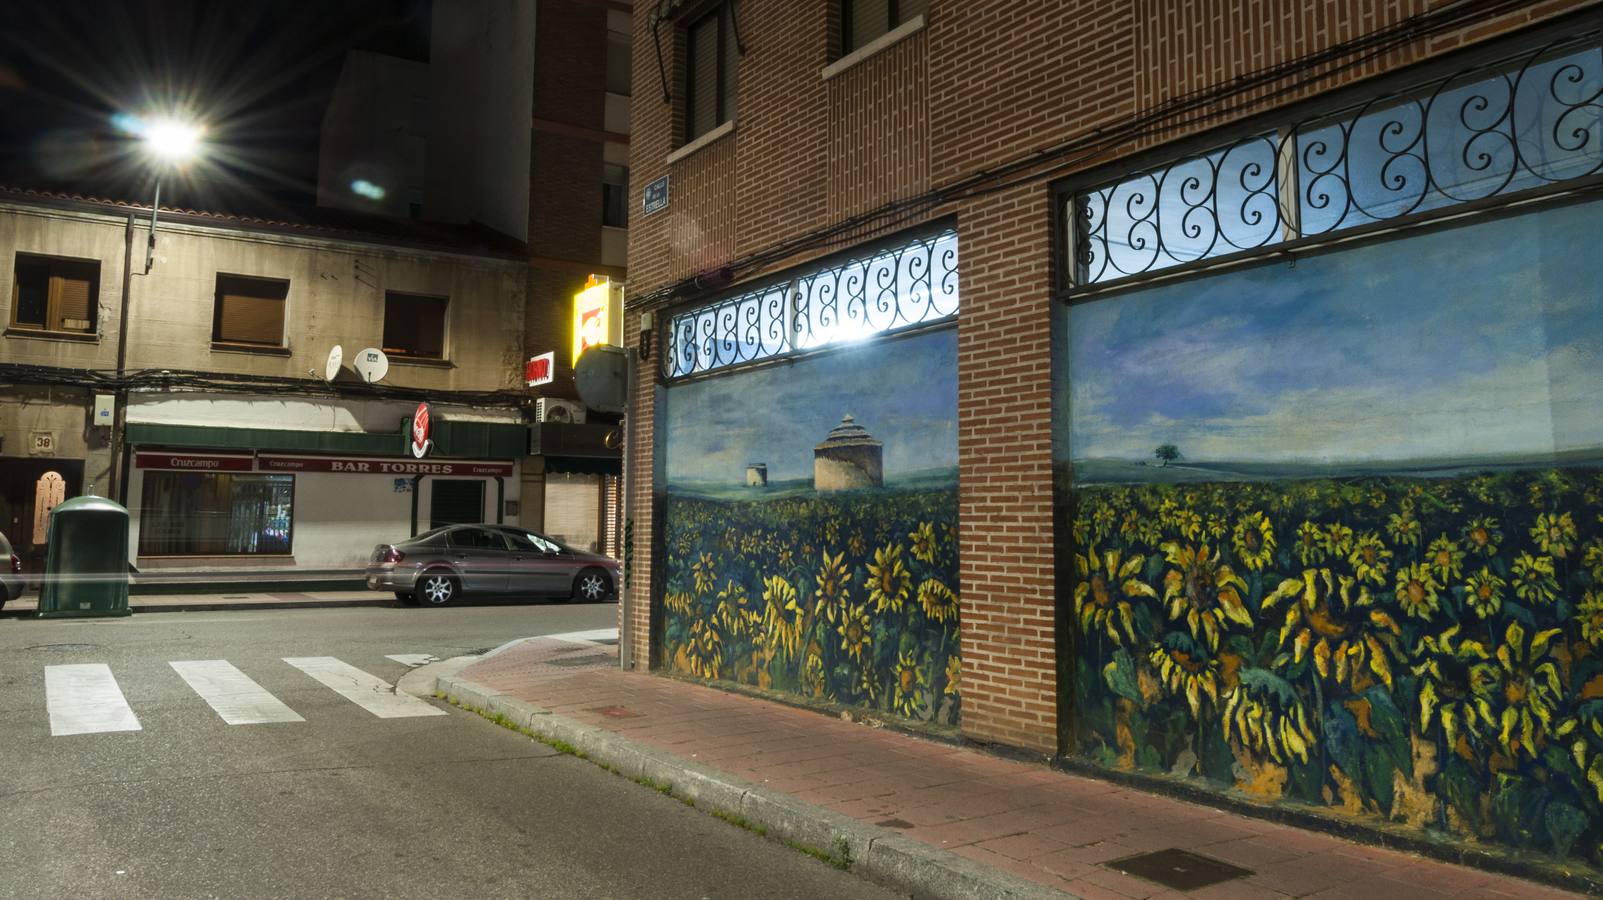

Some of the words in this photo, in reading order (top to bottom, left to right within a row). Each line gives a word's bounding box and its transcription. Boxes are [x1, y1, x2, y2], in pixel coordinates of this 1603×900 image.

[36, 437, 51, 448] 38
[170, 457, 220, 469] Cruzcampo
[269, 460, 304, 468] Cruzcampo
[331, 461, 371, 473] BAR
[380, 463, 453, 474] TORRES
